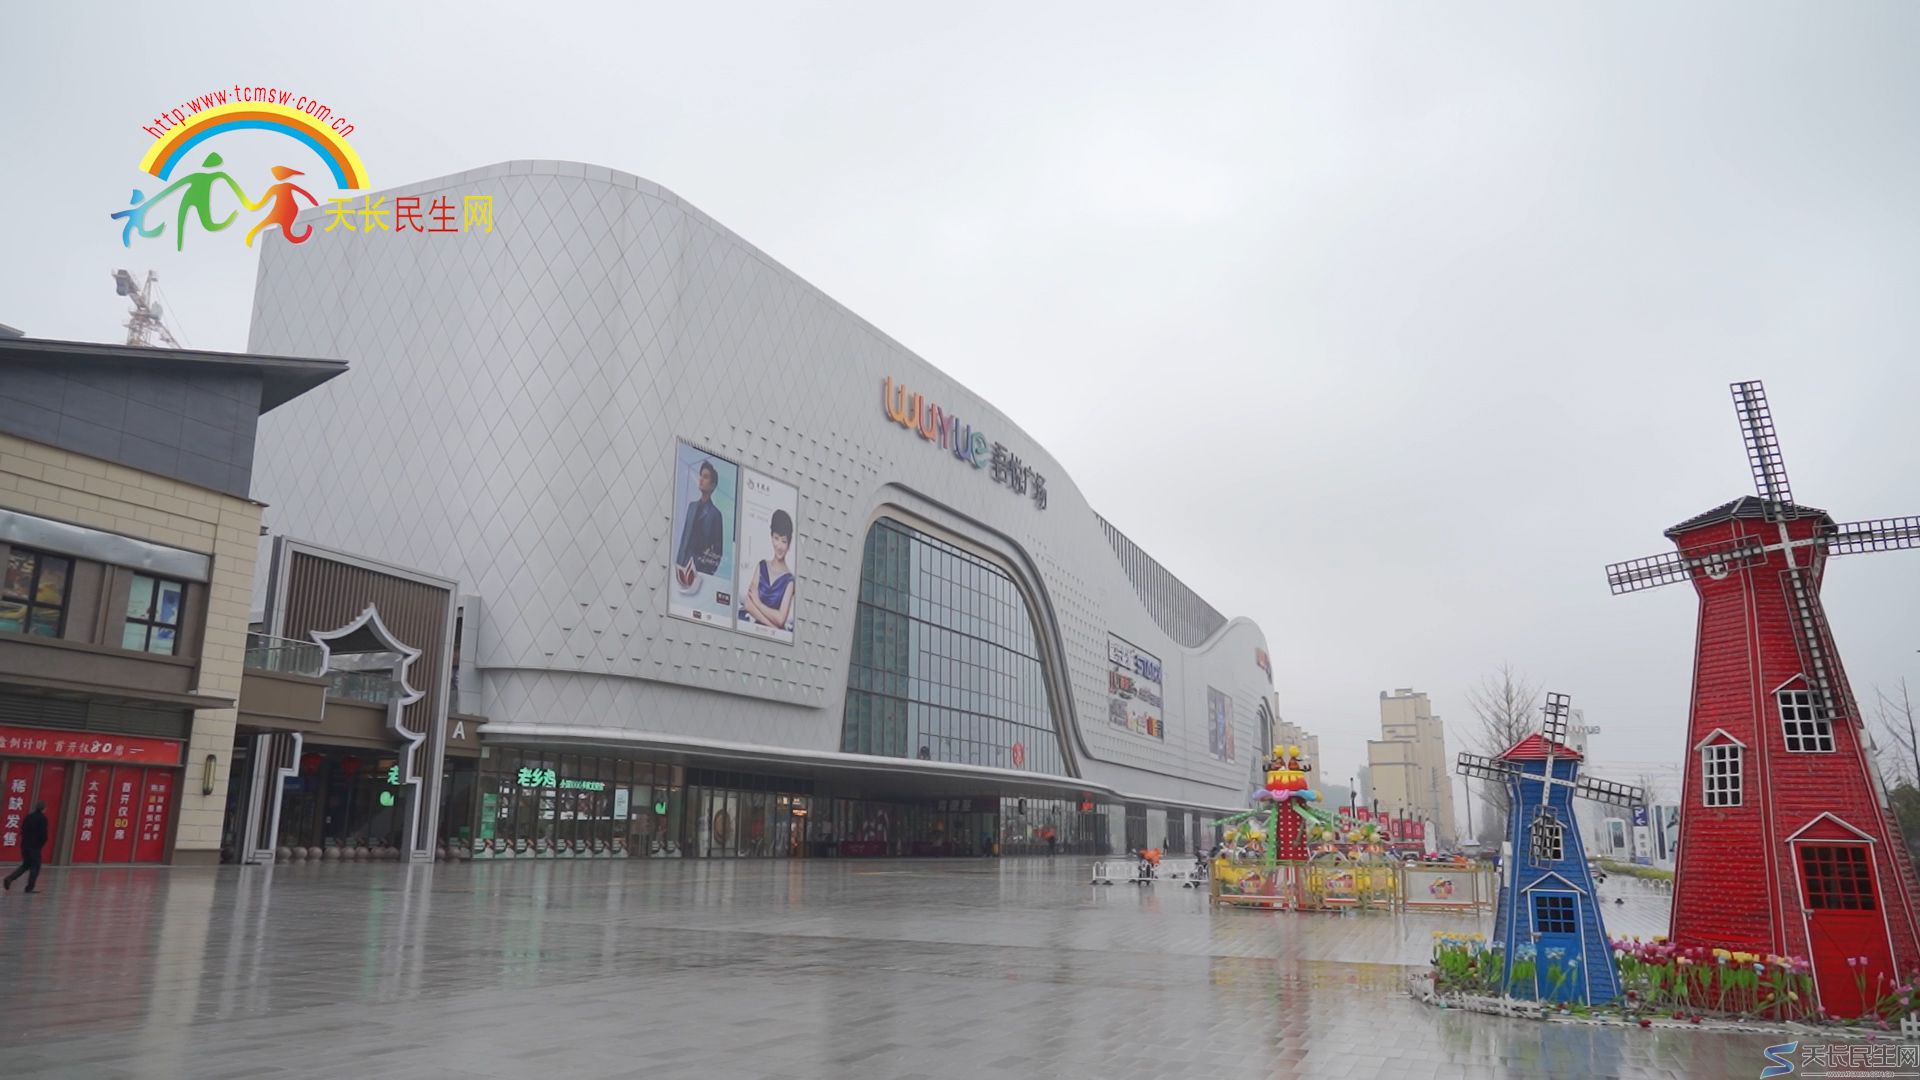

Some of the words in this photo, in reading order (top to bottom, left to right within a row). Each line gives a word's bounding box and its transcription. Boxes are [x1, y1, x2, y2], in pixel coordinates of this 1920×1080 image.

[990, 441, 1048, 511] 吾悦广场
[452, 721, 466, 740] A
[517, 767, 557, 788] 老乡鸡
[3, 778, 27, 847] 稀缺发售
